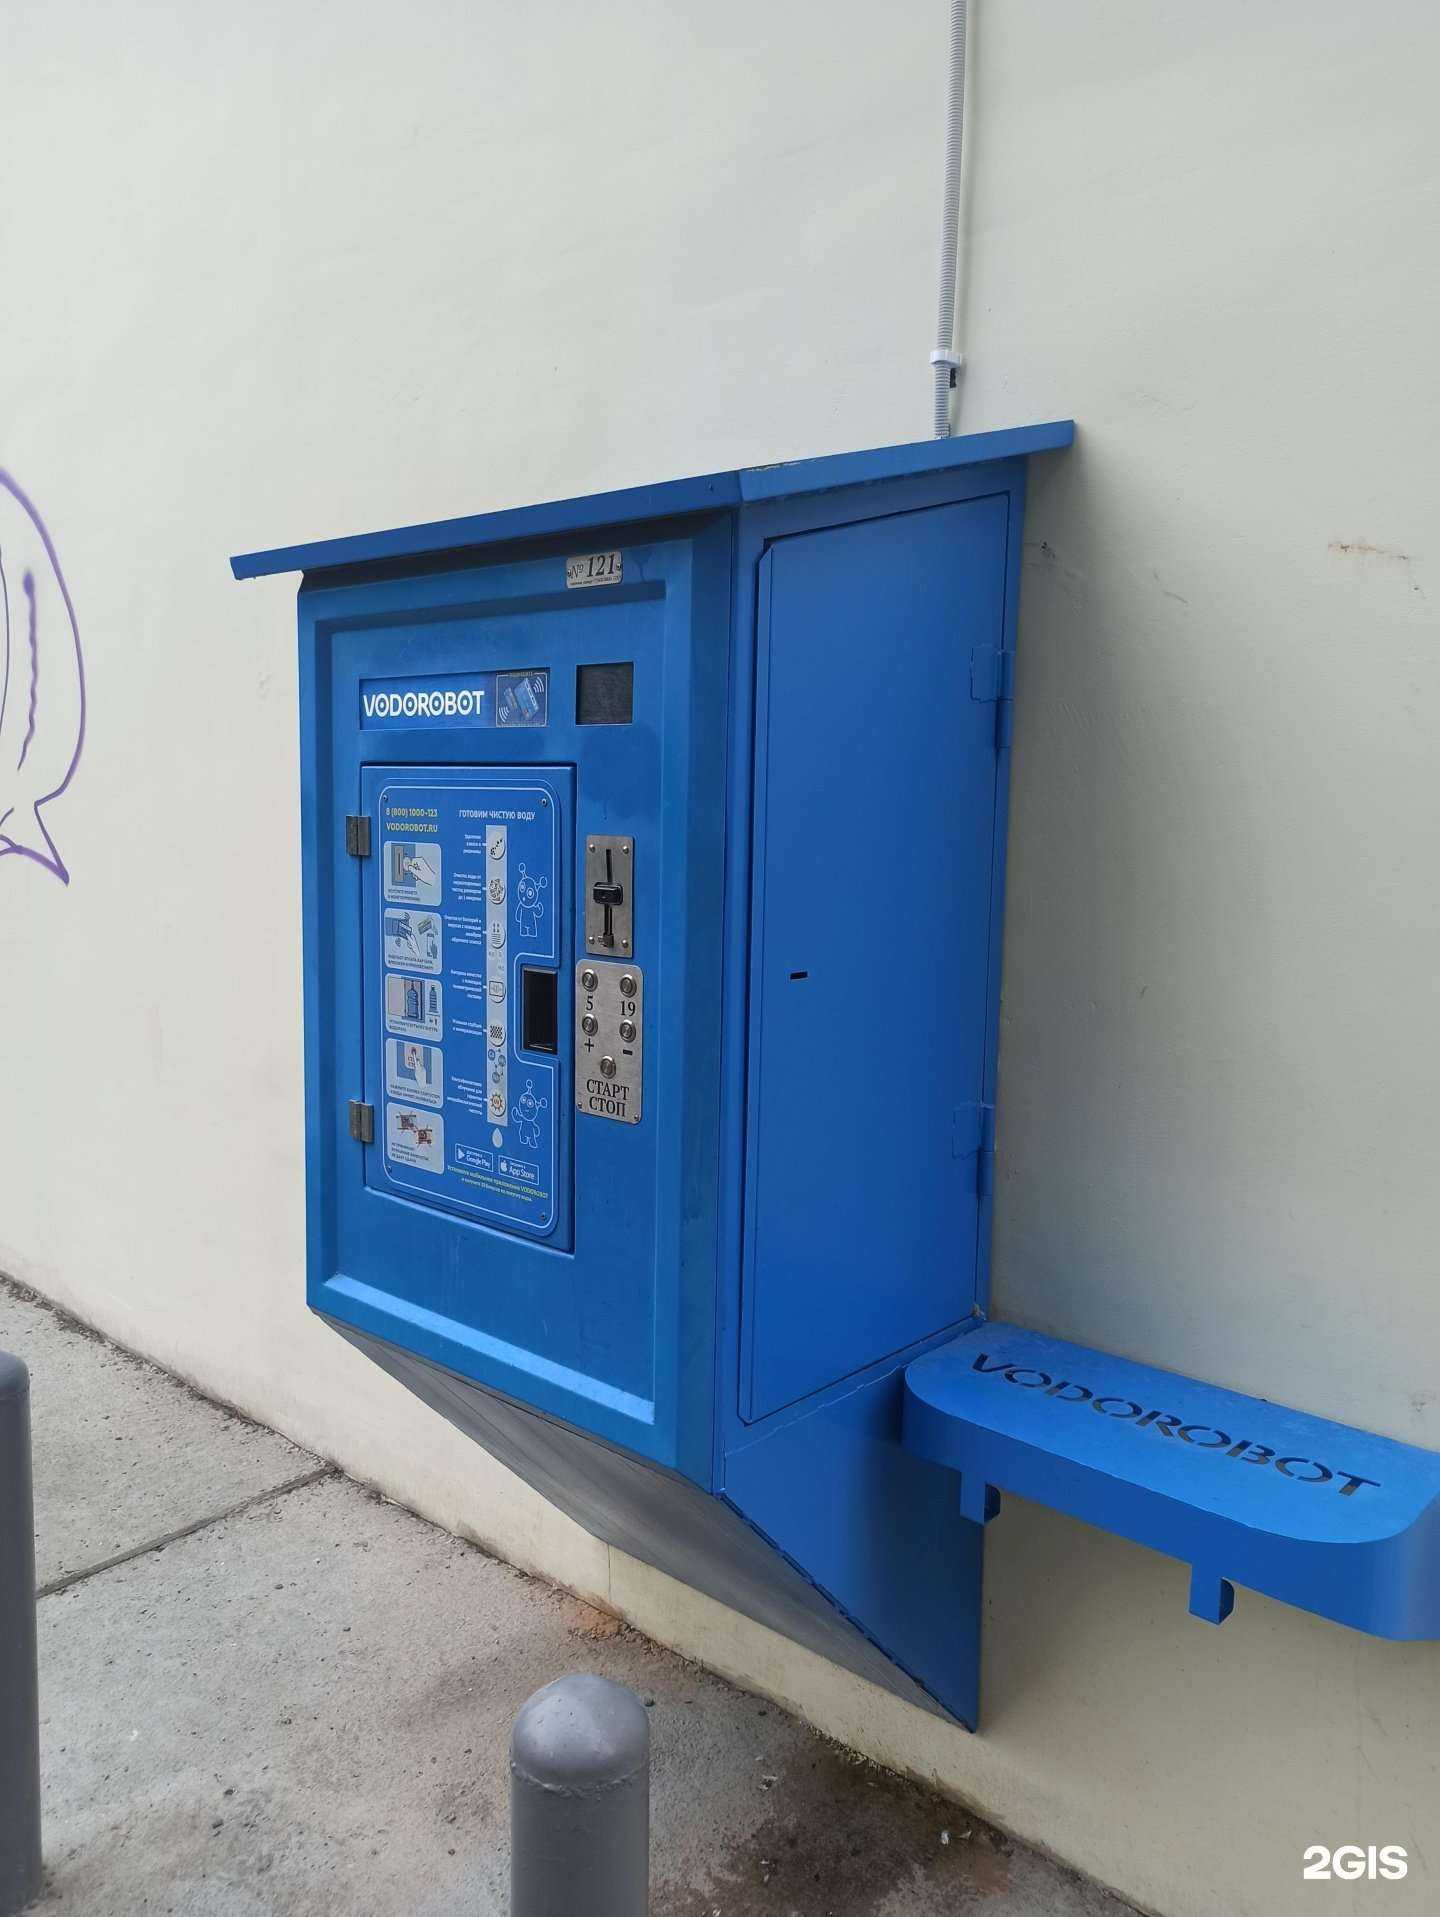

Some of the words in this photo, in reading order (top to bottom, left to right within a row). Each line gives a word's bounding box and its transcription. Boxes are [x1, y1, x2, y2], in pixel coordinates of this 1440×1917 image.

[586, 553, 615, 578] 121
[362, 690, 485, 718] VODOROBOT
[385, 807, 391, 816] 8
[458, 809, 488, 819] ГОТОВИМ
[489, 810, 515, 820] ЧИСТУЮ
[517, 811, 536, 822] ВОДУ
[386, 822, 438, 833] VODOROBOT.RU
[585, 995, 594, 1011] 5
[620, 1001, 636, 1017] 19
[586, 1078, 630, 1101] СТАРТ
[588, 1096, 626, 1118] СТОП
[509, 1166, 520, 1176] App
[520, 1168, 535, 1180] Store
[970, 1352, 1382, 1497] VODOROBOT
